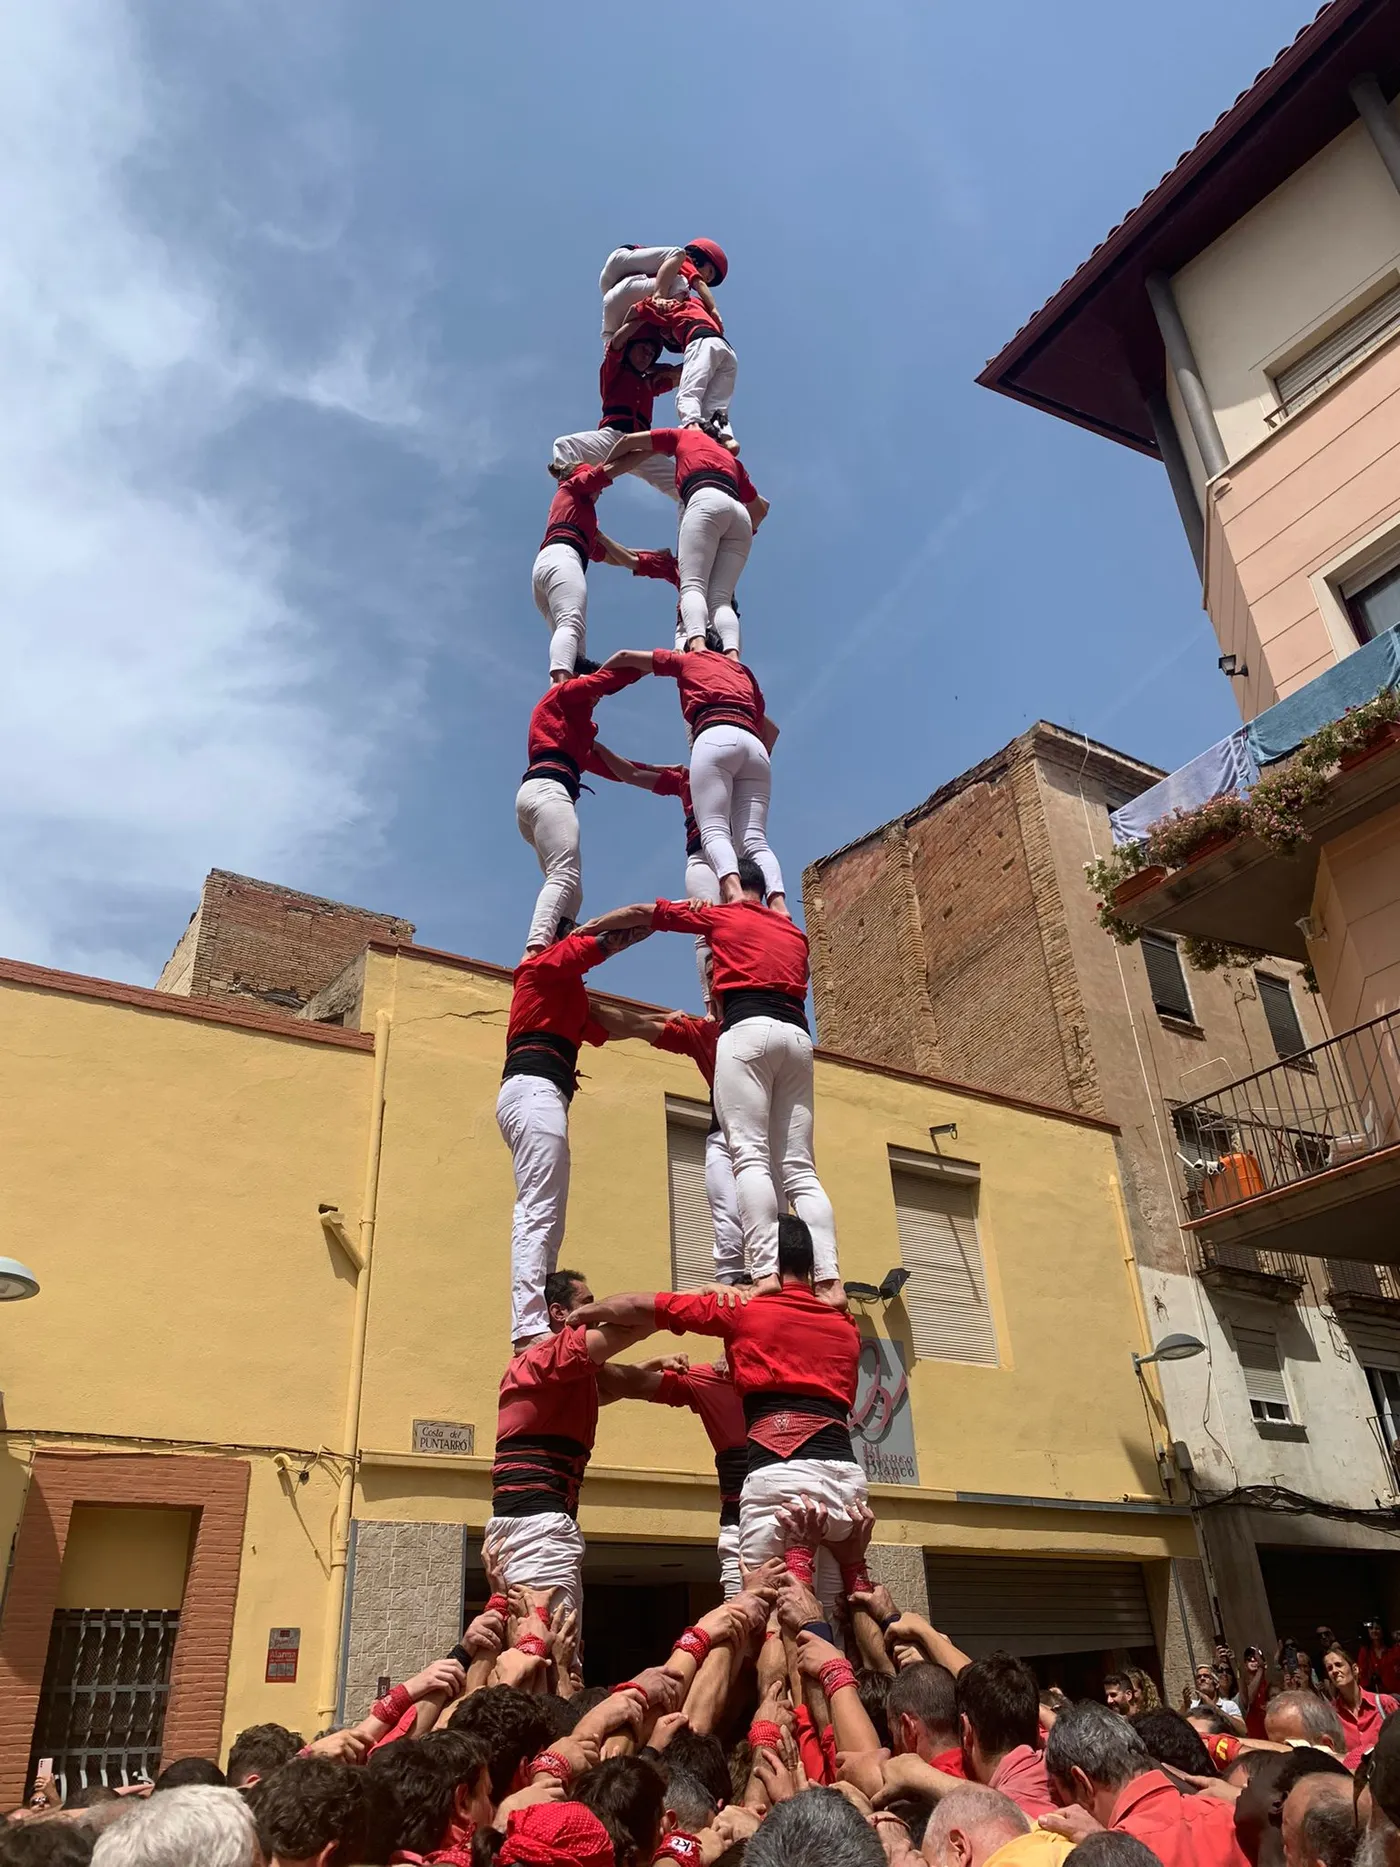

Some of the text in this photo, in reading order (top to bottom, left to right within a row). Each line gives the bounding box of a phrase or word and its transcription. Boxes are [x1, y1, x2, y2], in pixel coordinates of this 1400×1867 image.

[422, 1426, 462, 1439] Costa del
[420, 1437, 468, 1452] PUNTARRÓ
